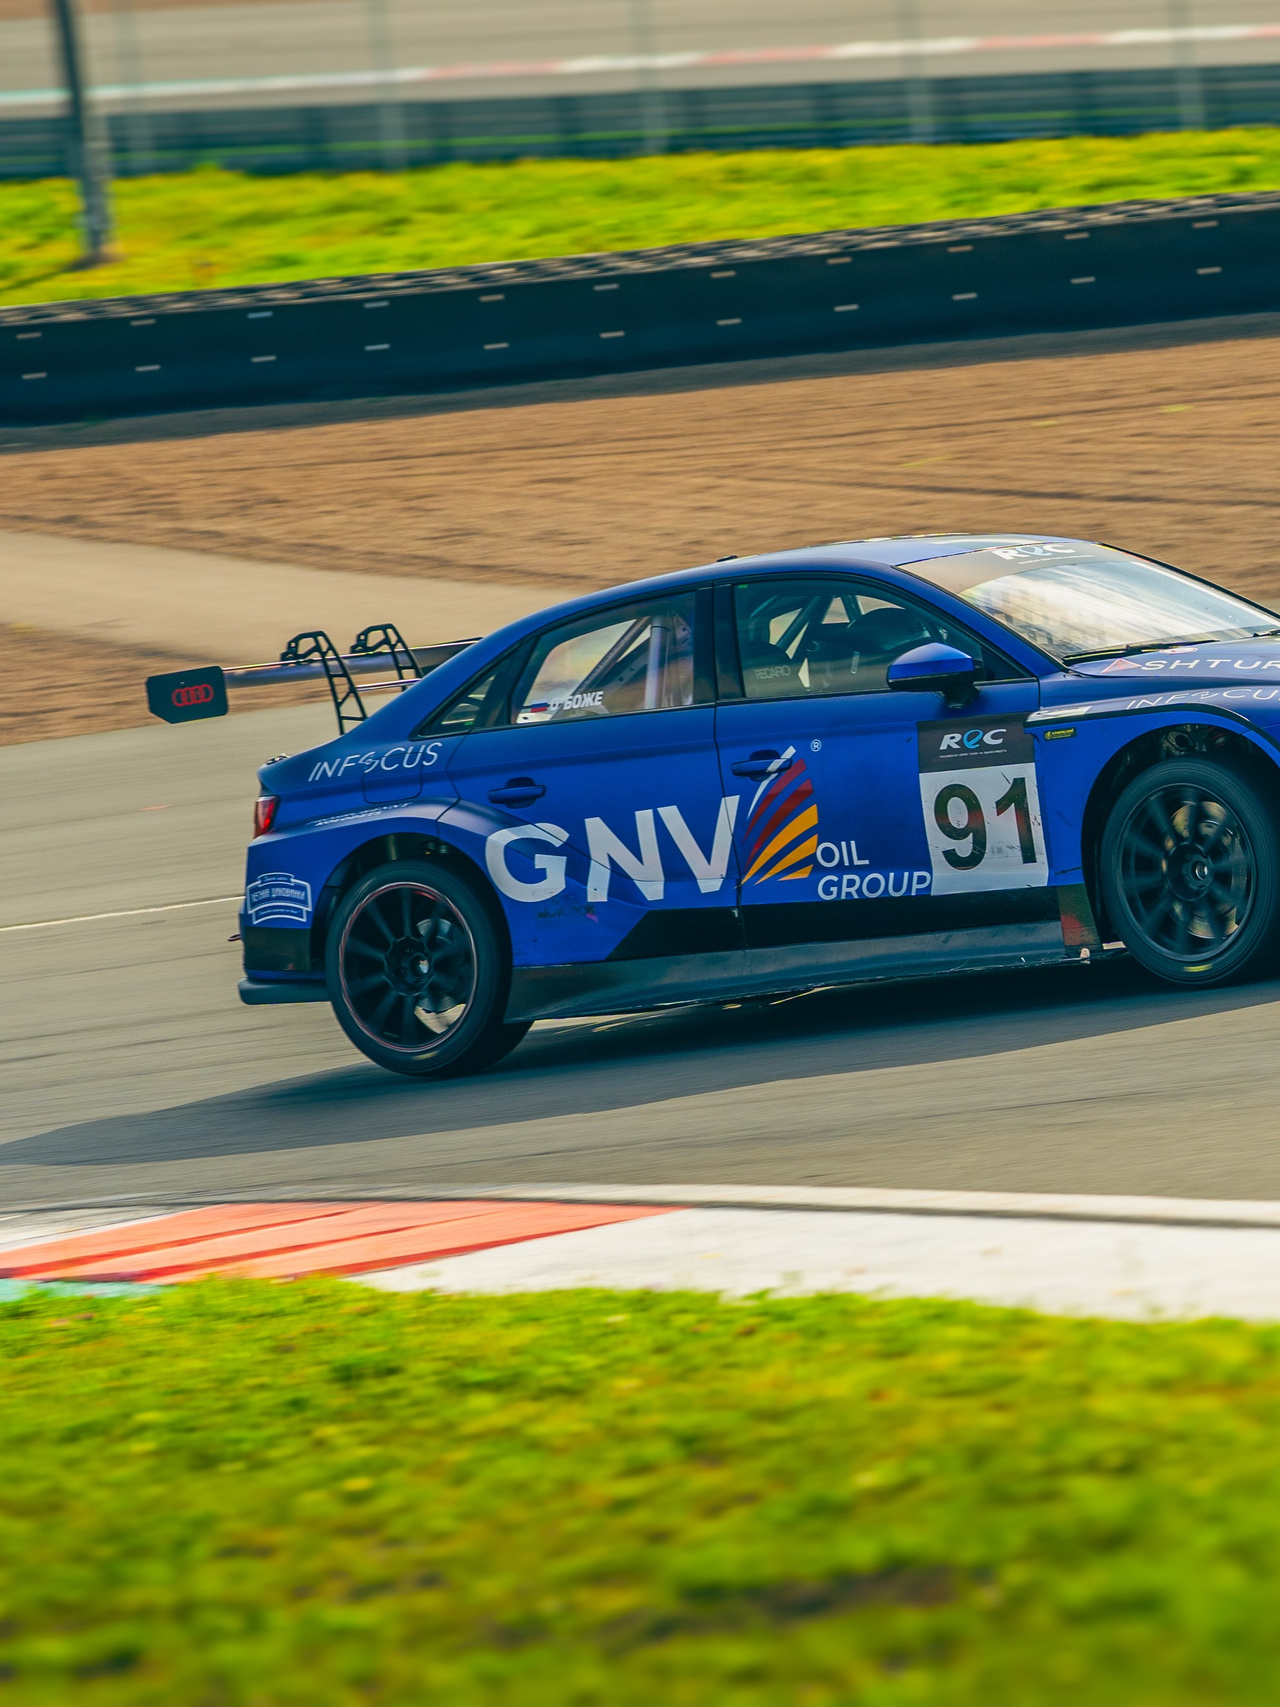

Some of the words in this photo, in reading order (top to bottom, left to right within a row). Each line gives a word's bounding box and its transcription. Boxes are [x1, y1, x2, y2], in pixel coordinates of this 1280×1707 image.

[754, 664, 791, 680] RECARO
[562, 691, 604, 711] БОЖЕ
[933, 776, 1038, 871] 91
[485, 794, 741, 903] GNV
[816, 840, 870, 868] OIL
[817, 871, 932, 901] GROUP
